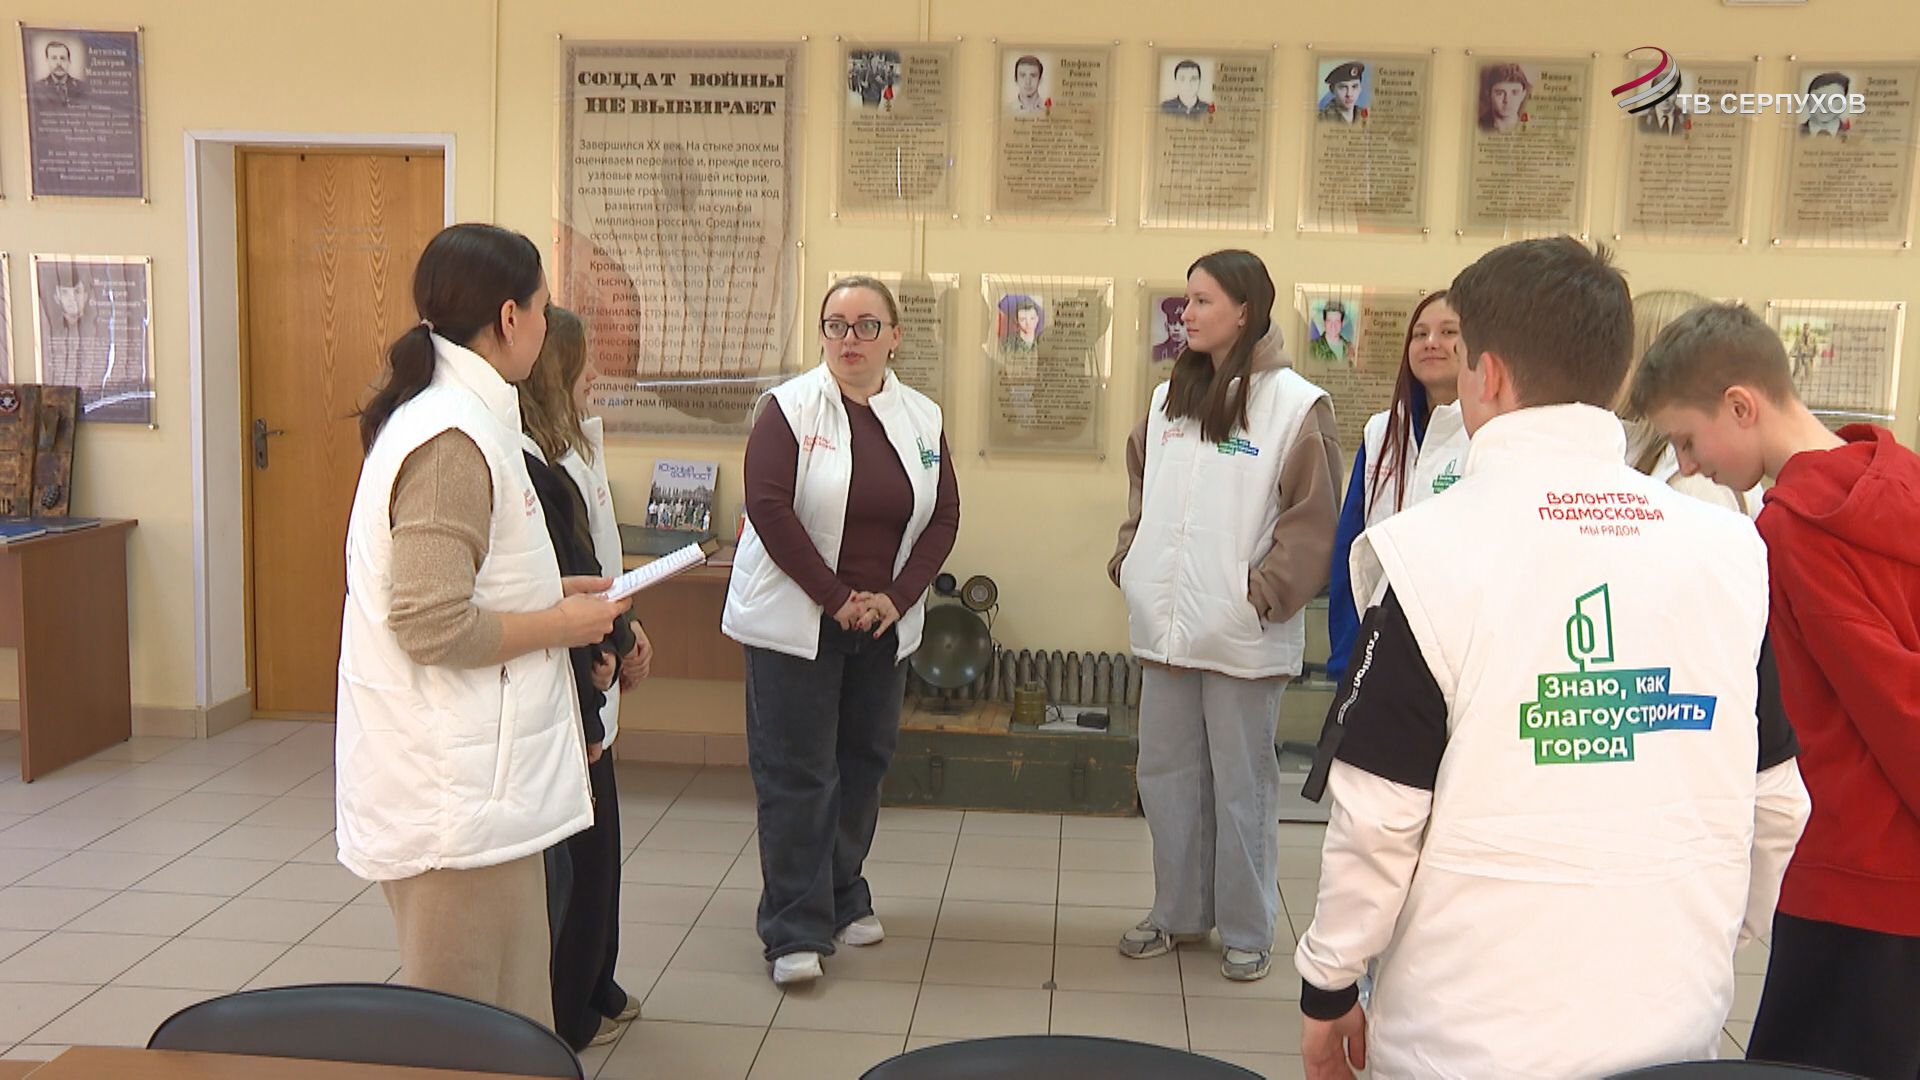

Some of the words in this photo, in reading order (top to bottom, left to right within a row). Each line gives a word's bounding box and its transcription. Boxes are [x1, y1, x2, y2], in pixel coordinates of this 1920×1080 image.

[577, 71, 677, 90] СОЛДАТ
[690, 71, 784, 88] ВОЙНЫ
[585, 97, 626, 113] НЕ
[630, 99, 777, 115] ВЫБИРАЕТ
[580, 139, 644, 152] Завершился
[686, 140, 700, 151] На
[702, 142, 734, 153] стыке
[736, 143, 761, 153] эпох
[763, 144, 779, 153] мы
[575, 156, 633, 167] оцениваем
[636, 157, 694, 168] пережитое
[708, 159, 750, 169] прежде
[752, 160, 784, 170] всего,
[588, 171, 632, 182] узловые
[635, 172, 682, 181] моменты
[685, 171, 720, 183] нашей
[722, 173, 770, 185] истории,
[578, 186, 635, 196] оказавшие
[698, 189, 743, 199] влияние
[745, 190, 758, 199] на
[760, 190, 780, 201] ход
[604, 202, 653, 213] развития
[699, 204, 711, 212] на
[714, 202, 752, 215] судьбы
[594, 217, 655, 227] миллионов
[706, 217, 739, 229] Среди
[742, 219, 761, 228] них
[590, 231, 648, 242] особняком
[650, 232, 679, 242] стоят
[681, 233, 766, 245] необъявленные
[590, 261, 642, 272] Кровавый
[669, 264, 713, 276] которых
[723, 265, 765, 275] десятки
[597, 278, 627, 287] тысяч
[671, 280, 704, 289] около
[706, 279, 724, 289] 100
[578, 304, 641, 317] Изменилась
[721, 309, 776, 321] проблемы
[724, 326, 775, 336] недавние
[660, 383, 685, 394] долг
[687, 384, 719, 396] перед
[593, 397, 606, 407] не
[608, 397, 635, 408] дают
[637, 398, 657, 408] нам
[659, 399, 691, 411] права
[693, 400, 706, 410] на
[1546, 491, 1649, 505] ВОЛОНТЕРЫ
[1538, 506, 1664, 521] ПОДМОСКОВЬЯ
[1579, 525, 1599, 536] МЫ
[1601, 525, 1640, 537] РЯДОМ
[1544, 676, 1627, 700] Знаю,
[1635, 674, 1666, 694] как
[1526, 702, 1707, 730] благоустроить
[1541, 735, 1629, 761] город
